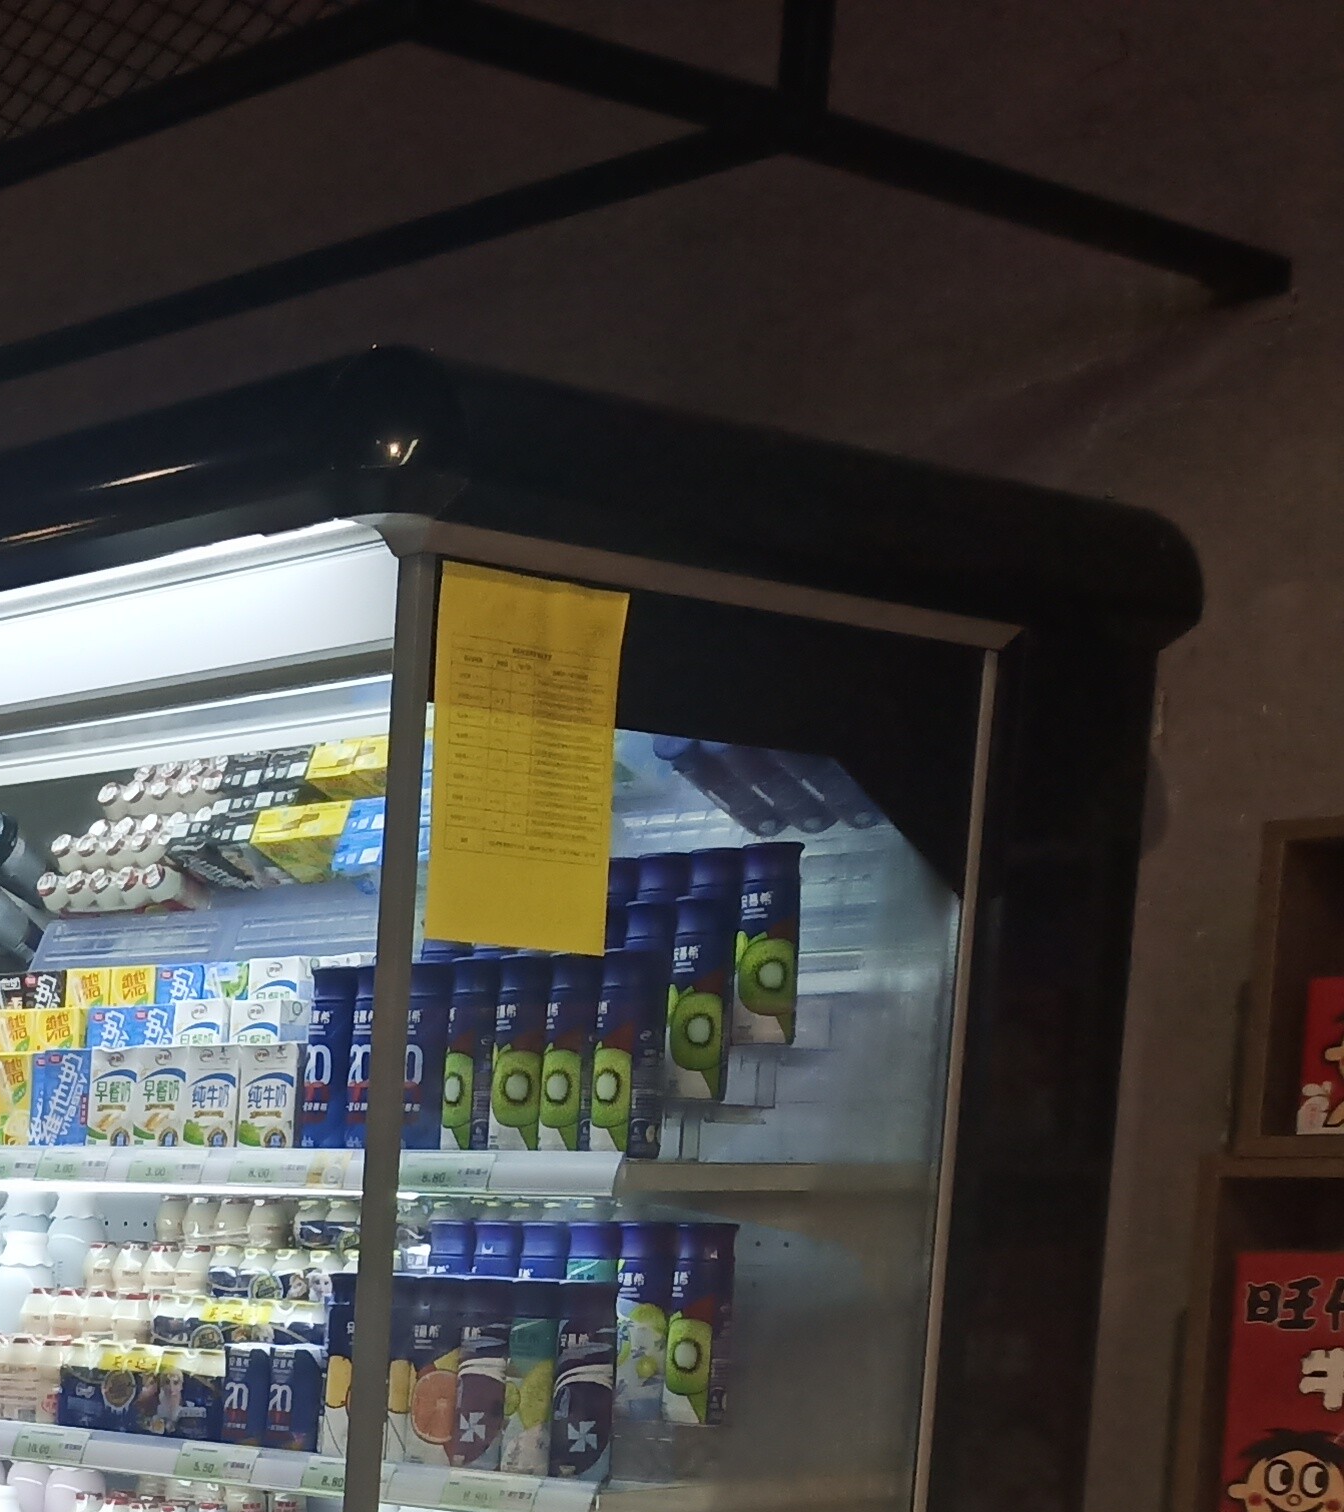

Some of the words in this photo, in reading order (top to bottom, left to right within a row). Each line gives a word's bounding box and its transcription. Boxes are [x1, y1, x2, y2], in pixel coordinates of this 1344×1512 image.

[94, 1080, 132, 1104] 早餐奶
[142, 1079, 181, 1103] 早餐奶
[192, 1084, 230, 1109] 纯牛奶
[247, 1083, 287, 1109] 纯牛奶
[223, 1381, 250, 1412] 20
[267, 1383, 293, 1414] 20
